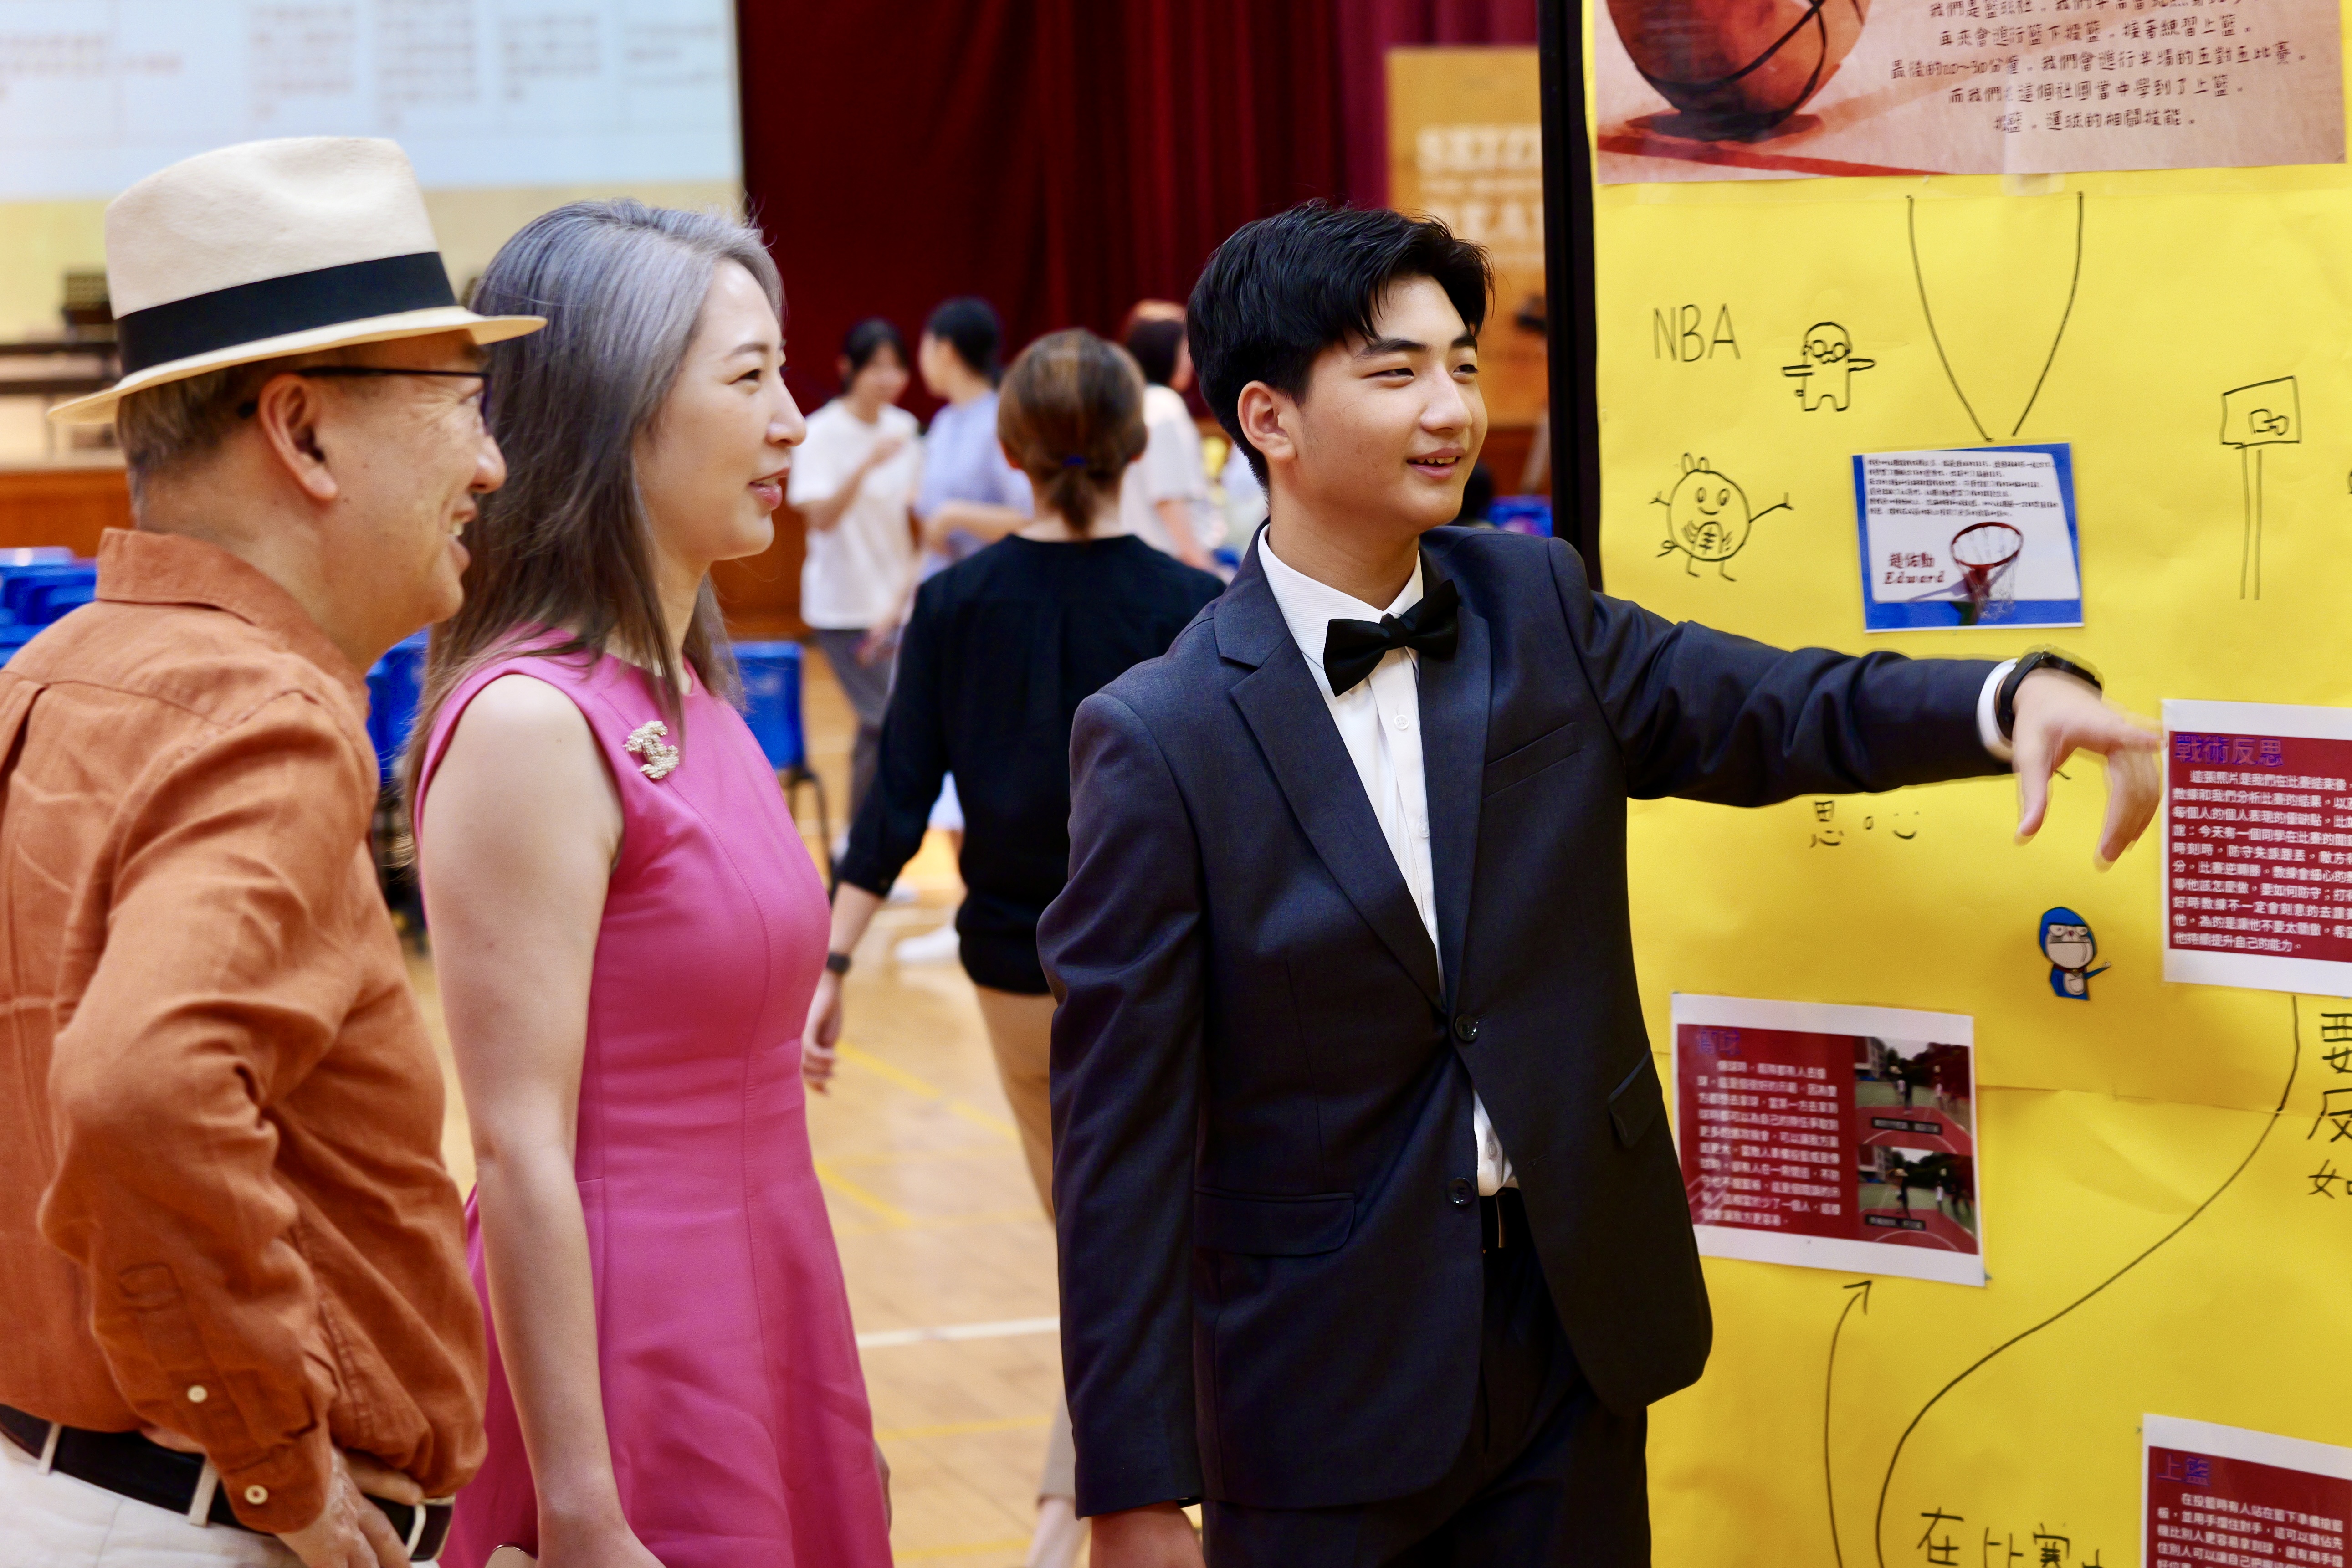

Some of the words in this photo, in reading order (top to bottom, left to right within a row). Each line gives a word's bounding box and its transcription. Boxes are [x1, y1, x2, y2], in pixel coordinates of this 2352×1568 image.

[1653, 303, 1741, 362] NBA
[1884, 570, 1945, 584] Edward
[2174, 734, 2284, 767] 戰術反思
